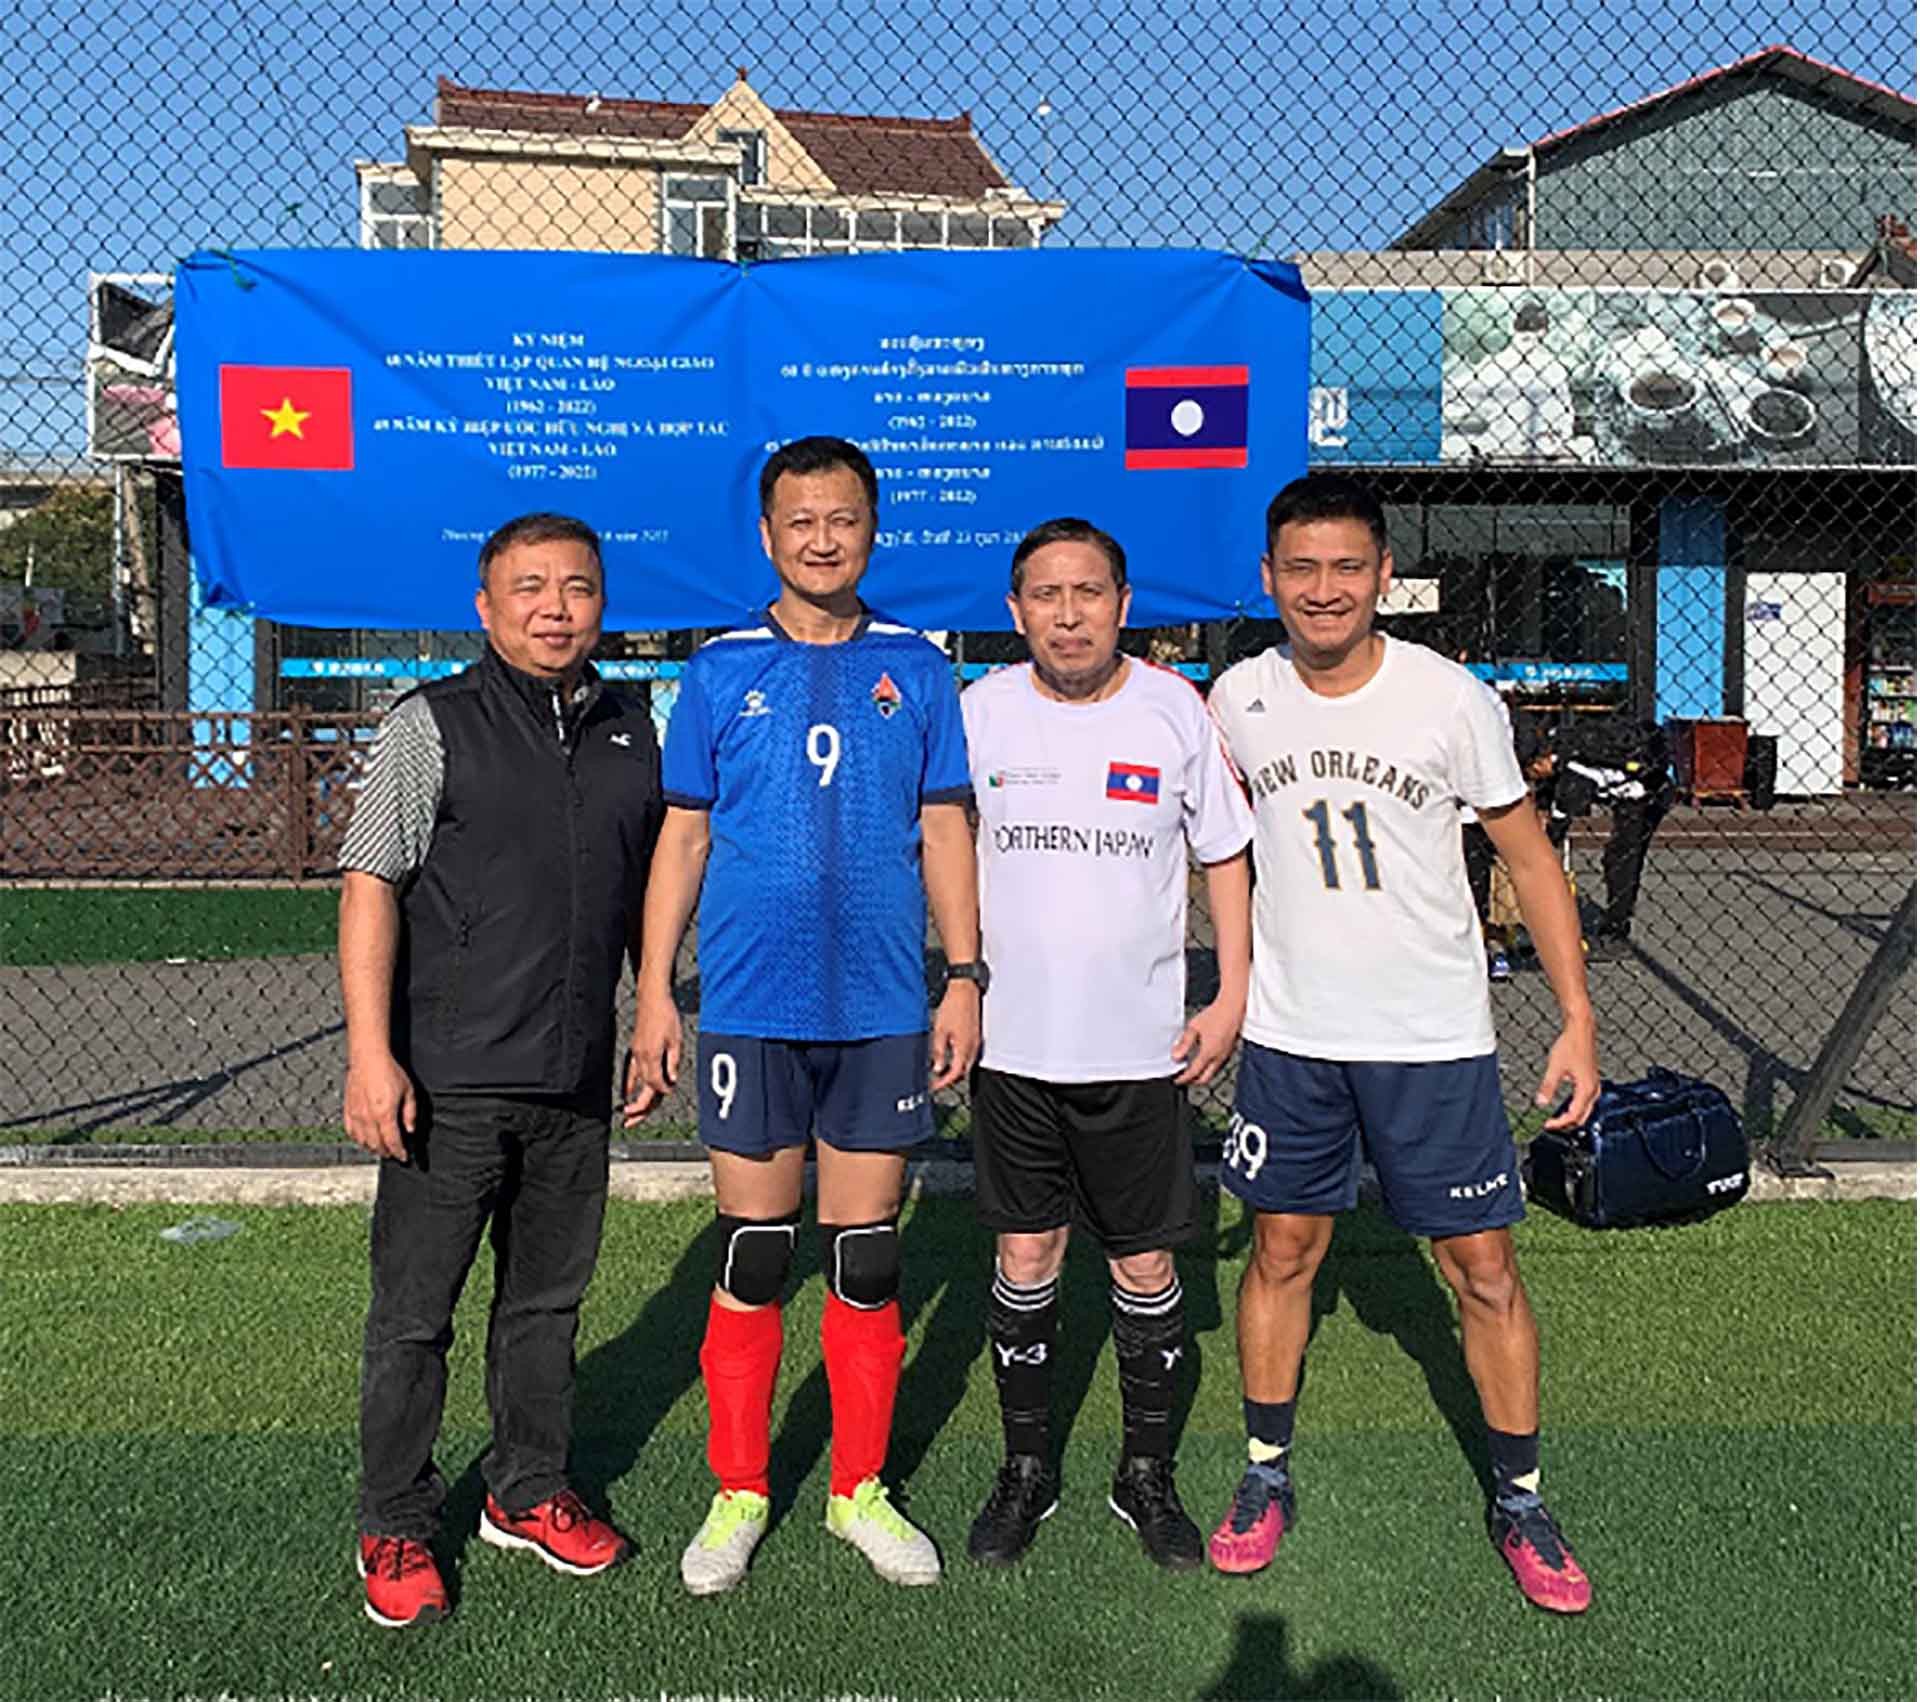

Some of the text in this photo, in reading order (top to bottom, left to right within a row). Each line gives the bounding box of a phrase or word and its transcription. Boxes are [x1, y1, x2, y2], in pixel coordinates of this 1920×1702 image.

[529, 378, 567, 391] NAM
[806, 724, 840, 788] 9
[1311, 750, 1430, 811] ORLEANS
[1302, 799, 1384, 892] 11
[711, 1052, 736, 1120] 9
[995, 1342, 1048, 1367] Y-3
